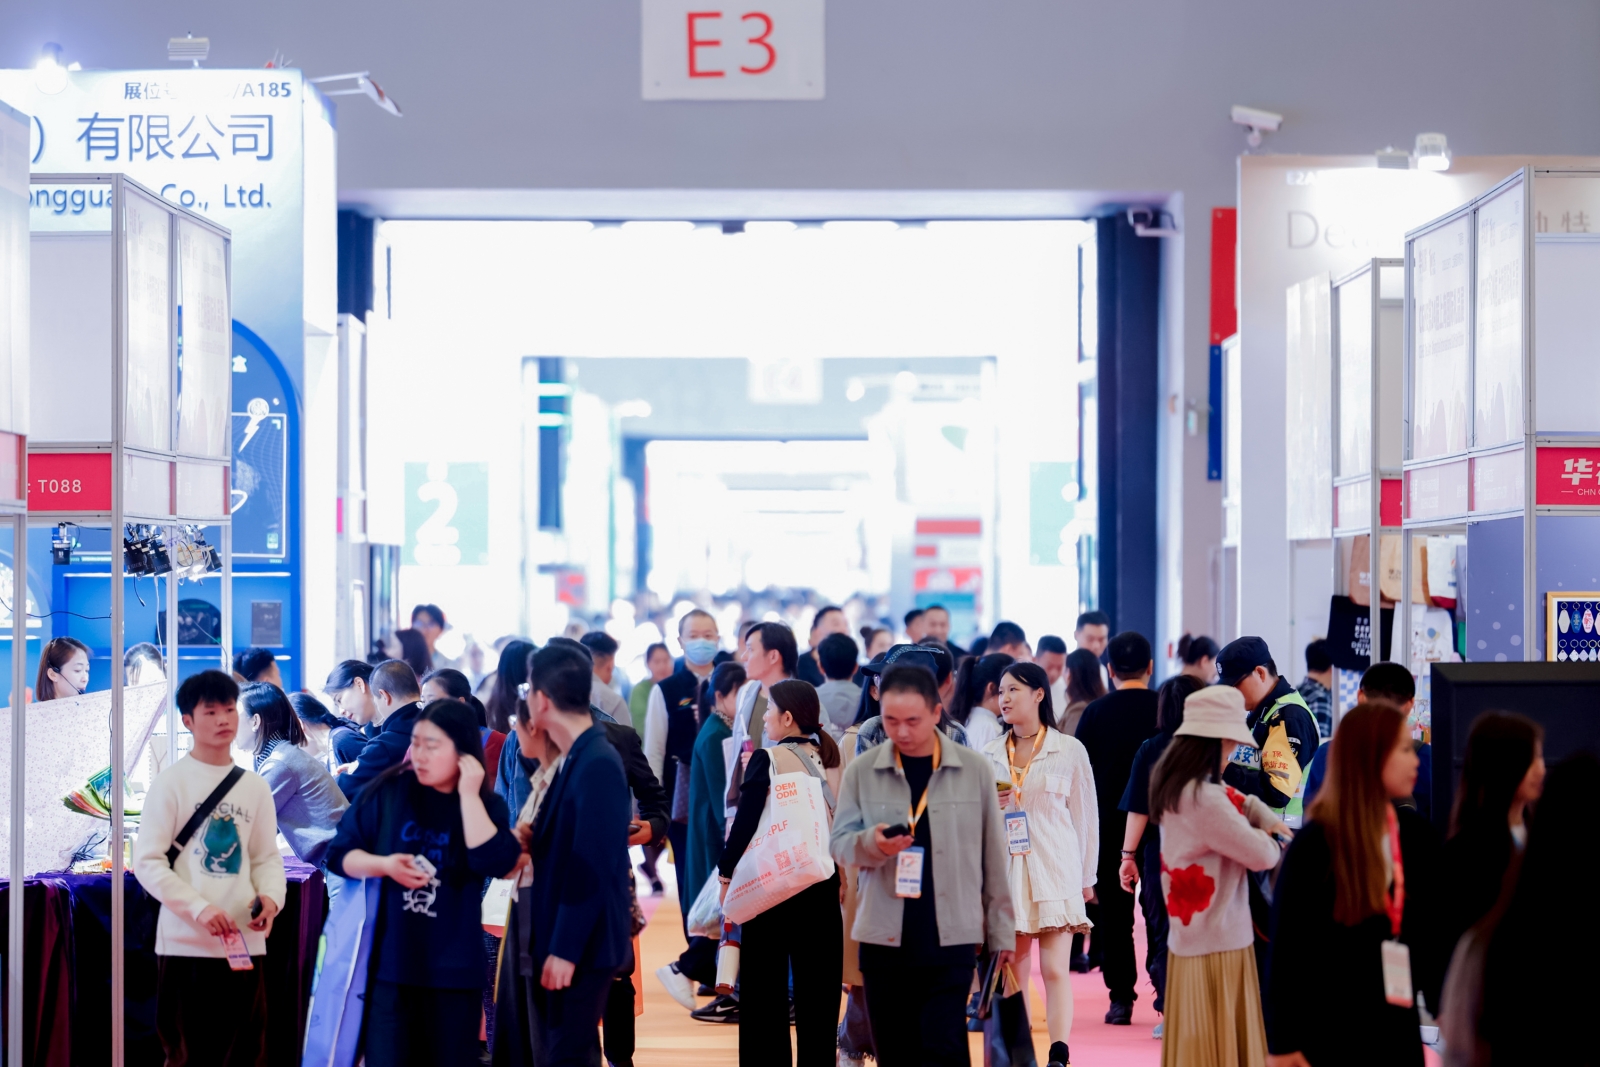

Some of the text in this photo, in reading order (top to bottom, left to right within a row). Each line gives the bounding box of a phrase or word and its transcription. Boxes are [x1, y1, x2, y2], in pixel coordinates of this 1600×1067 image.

[687, 12, 776, 77] E3
[77, 111, 275, 162] 有限公司
[225, 182, 272, 208] Ltd.
[1561, 458, 1600, 486] 华
[38, 479, 82, 493] T088
[1577, 488, 1596, 496] CHN
[774, 782, 797, 792] OEM
[776, 789, 798, 800] ODM
